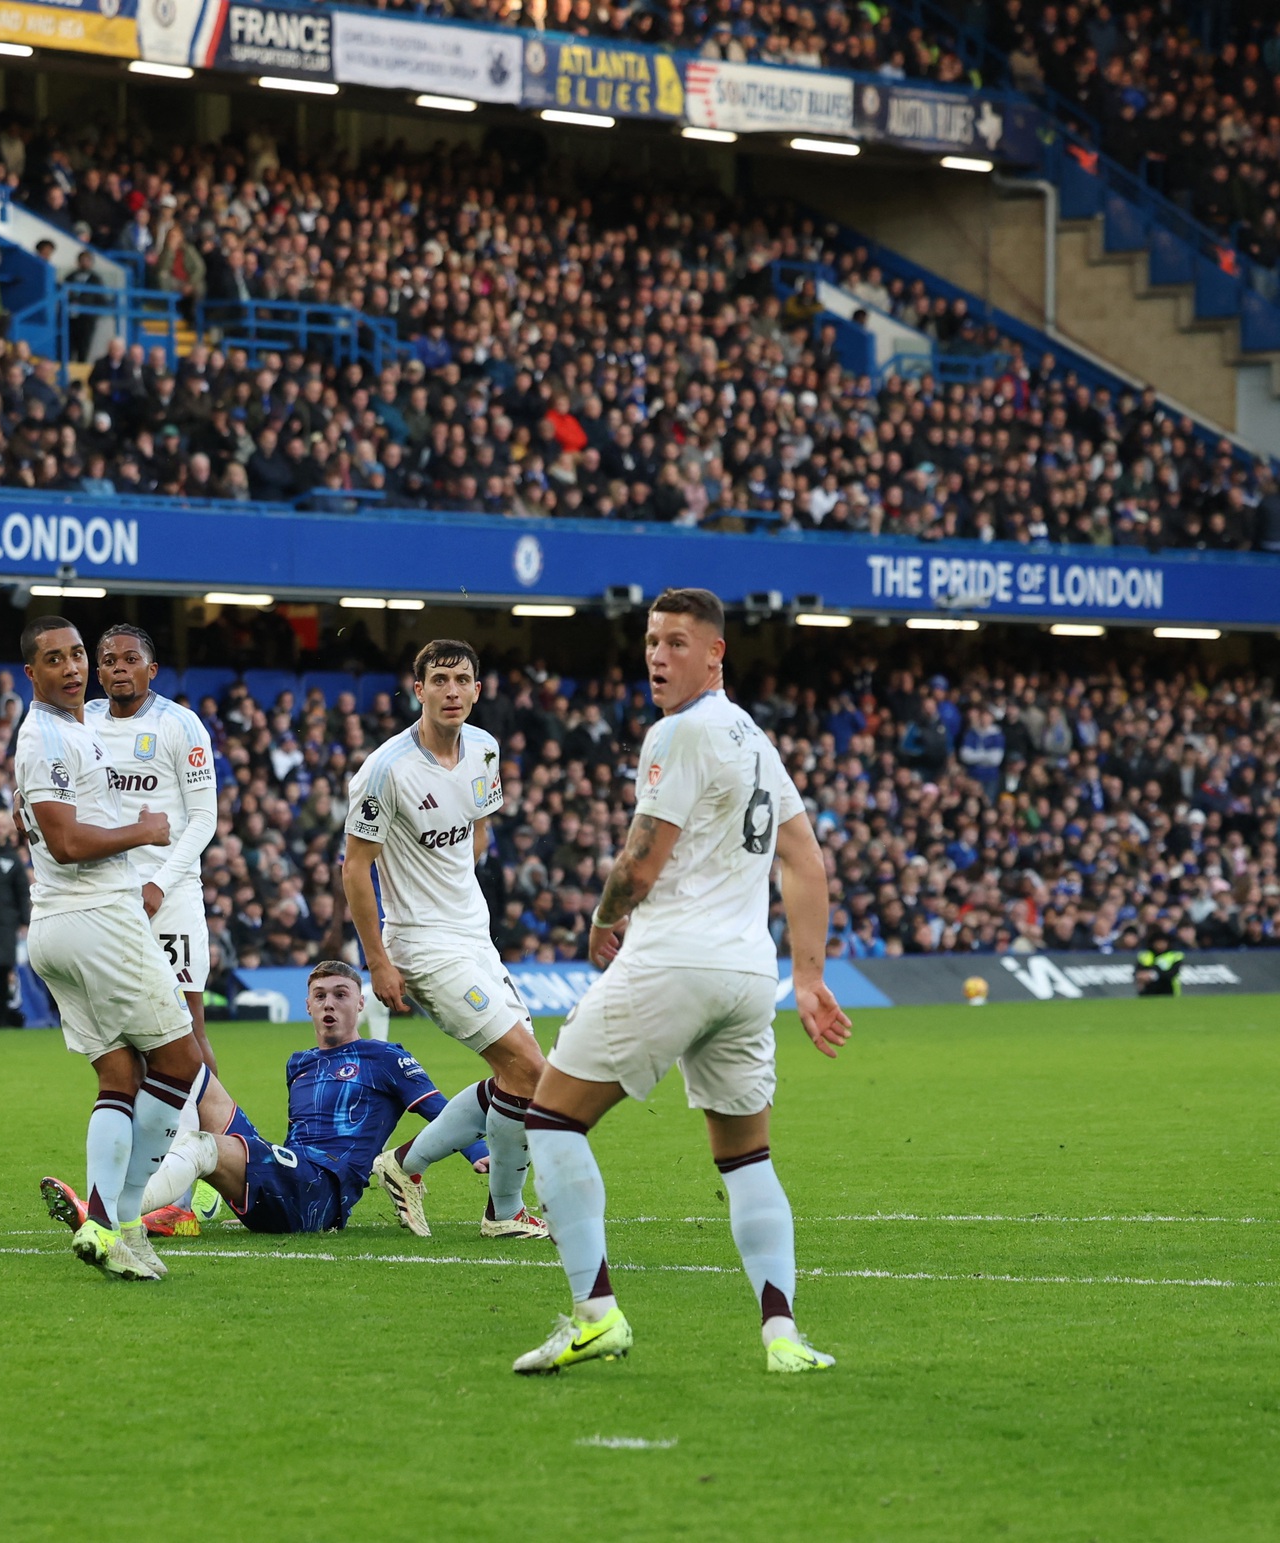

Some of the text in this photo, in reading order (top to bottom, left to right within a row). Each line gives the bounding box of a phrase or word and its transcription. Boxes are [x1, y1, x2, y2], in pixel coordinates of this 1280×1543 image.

[228, 5, 331, 55] FRANCE
[558, 44, 651, 83] ATLANTA
[555, 75, 652, 114] BLUES
[715, 77, 804, 113] SOUTHEAST
[807, 89, 854, 119] BLUES
[867, 555, 1163, 610] THE PRIDE OF LONDON
[742, 752, 774, 855] 6
[159, 934, 191, 967] 31
[165, 1128, 177, 1138] 18
